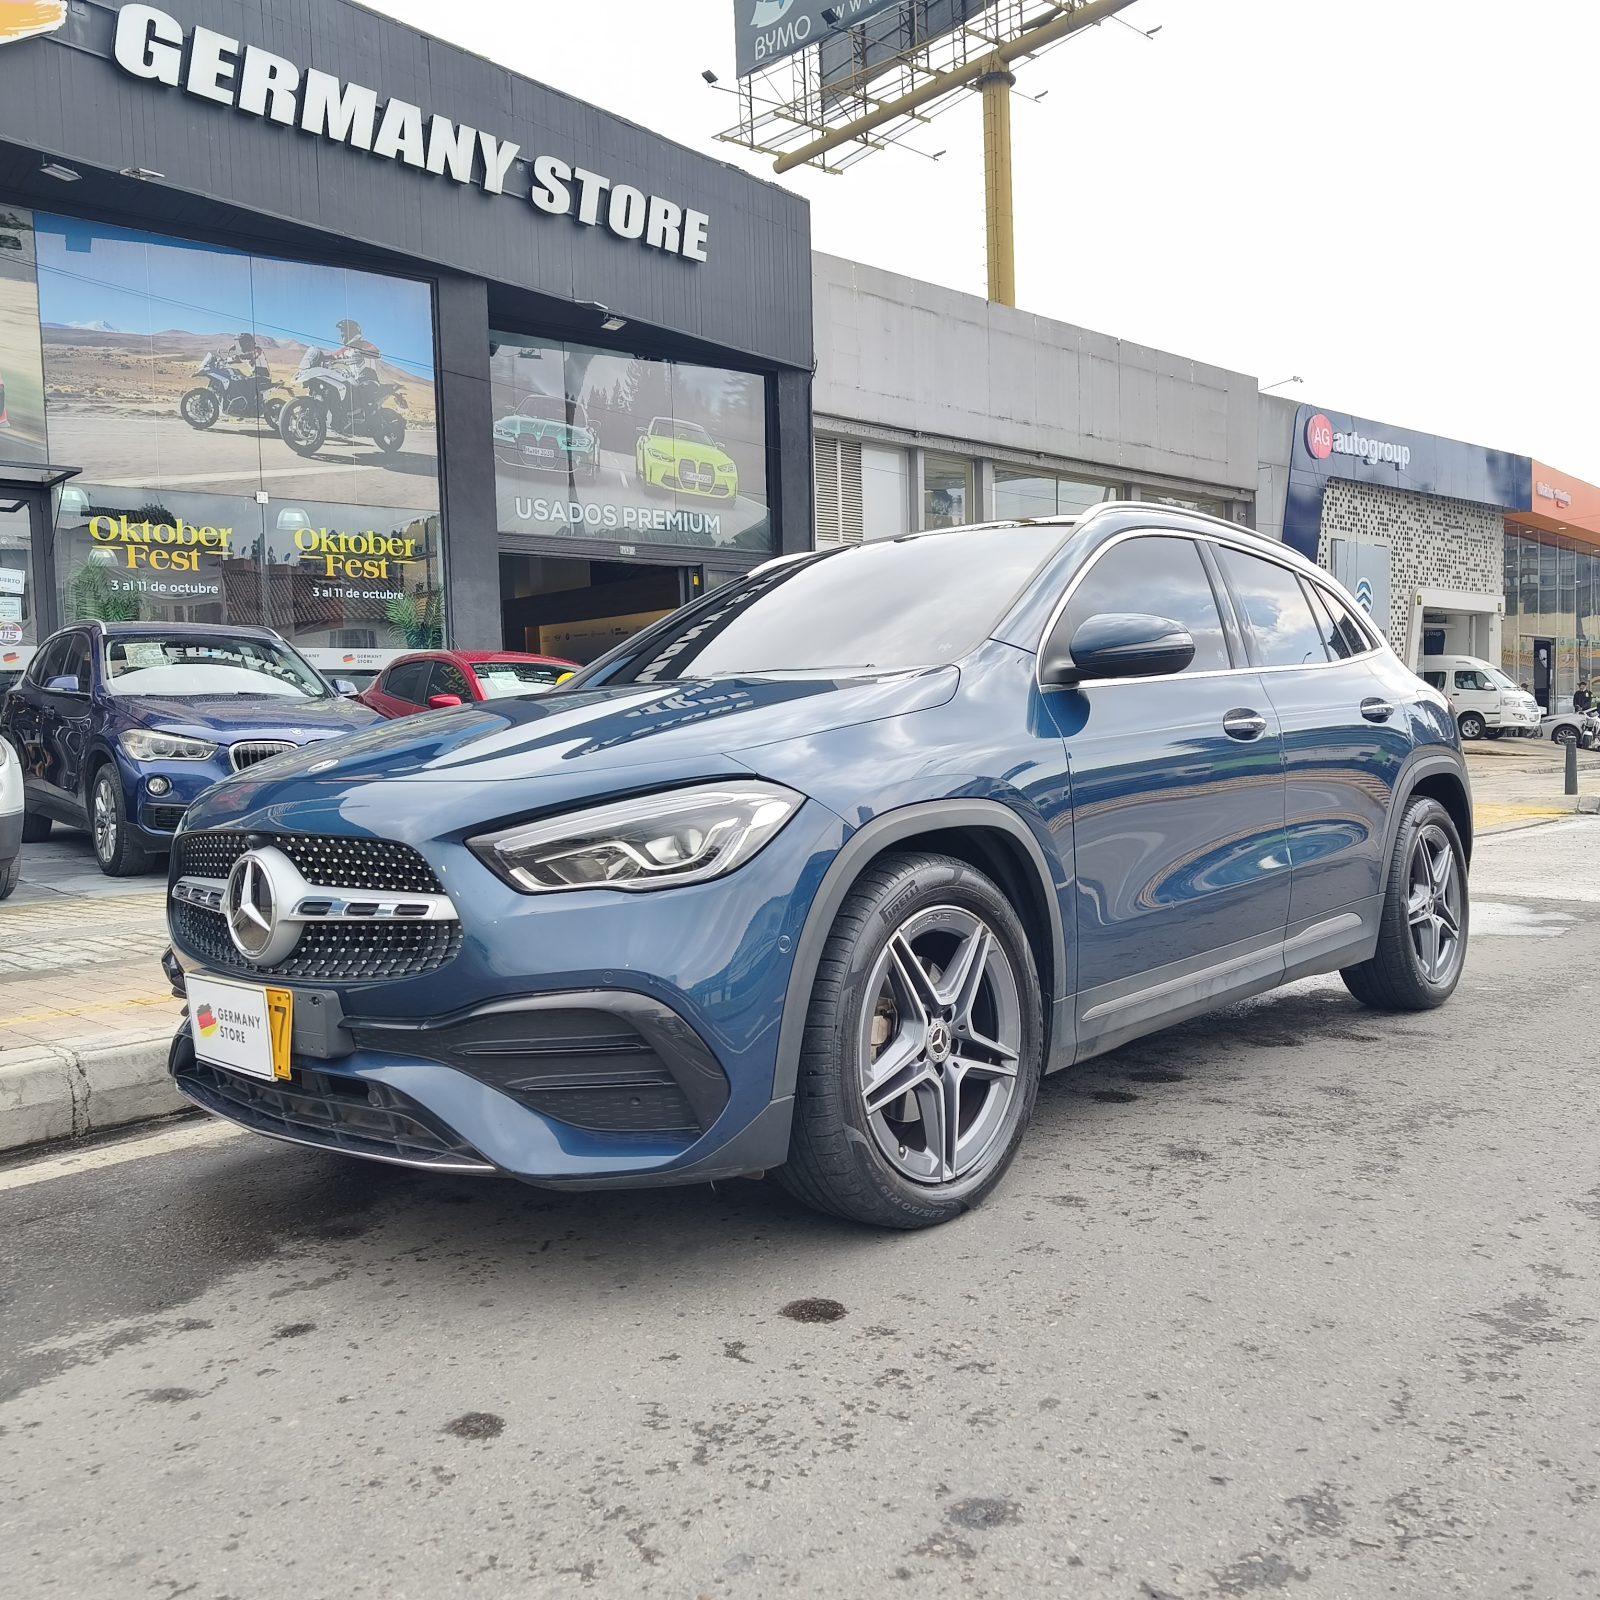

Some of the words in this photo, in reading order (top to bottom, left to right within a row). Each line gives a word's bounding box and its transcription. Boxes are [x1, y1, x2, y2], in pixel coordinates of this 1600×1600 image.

[755, 15, 811, 61] BYMO
[114, 3, 520, 195] GERMANY
[531, 155, 710, 263] STORE
[1314, 427, 1330, 446] AG
[1332, 431, 1411, 470] autogroup
[88, 515, 233, 547] Oktober
[514, 497, 617, 526] USADOS
[623, 506, 721, 535] PREMIUM
[294, 527, 416, 557] Oktober
[125, 544, 202, 572] Fest
[325, 554, 390, 579] Fest
[111, 580, 119, 591] 3
[122, 581, 134, 591] al
[136, 581, 147, 591] 11
[150, 581, 167, 592] de
[169, 583, 219, 594] octubre
[312, 587, 320, 597] 3
[322, 588, 332, 597] al
[334, 588, 343, 598] 11
[345, 588, 360, 598] de
[362, 589, 404, 600] octubre
[879, 880, 920, 925] PIRELLI
[217, 1008, 261, 1029] GERMANY
[219, 1026, 246, 1043] STORE
